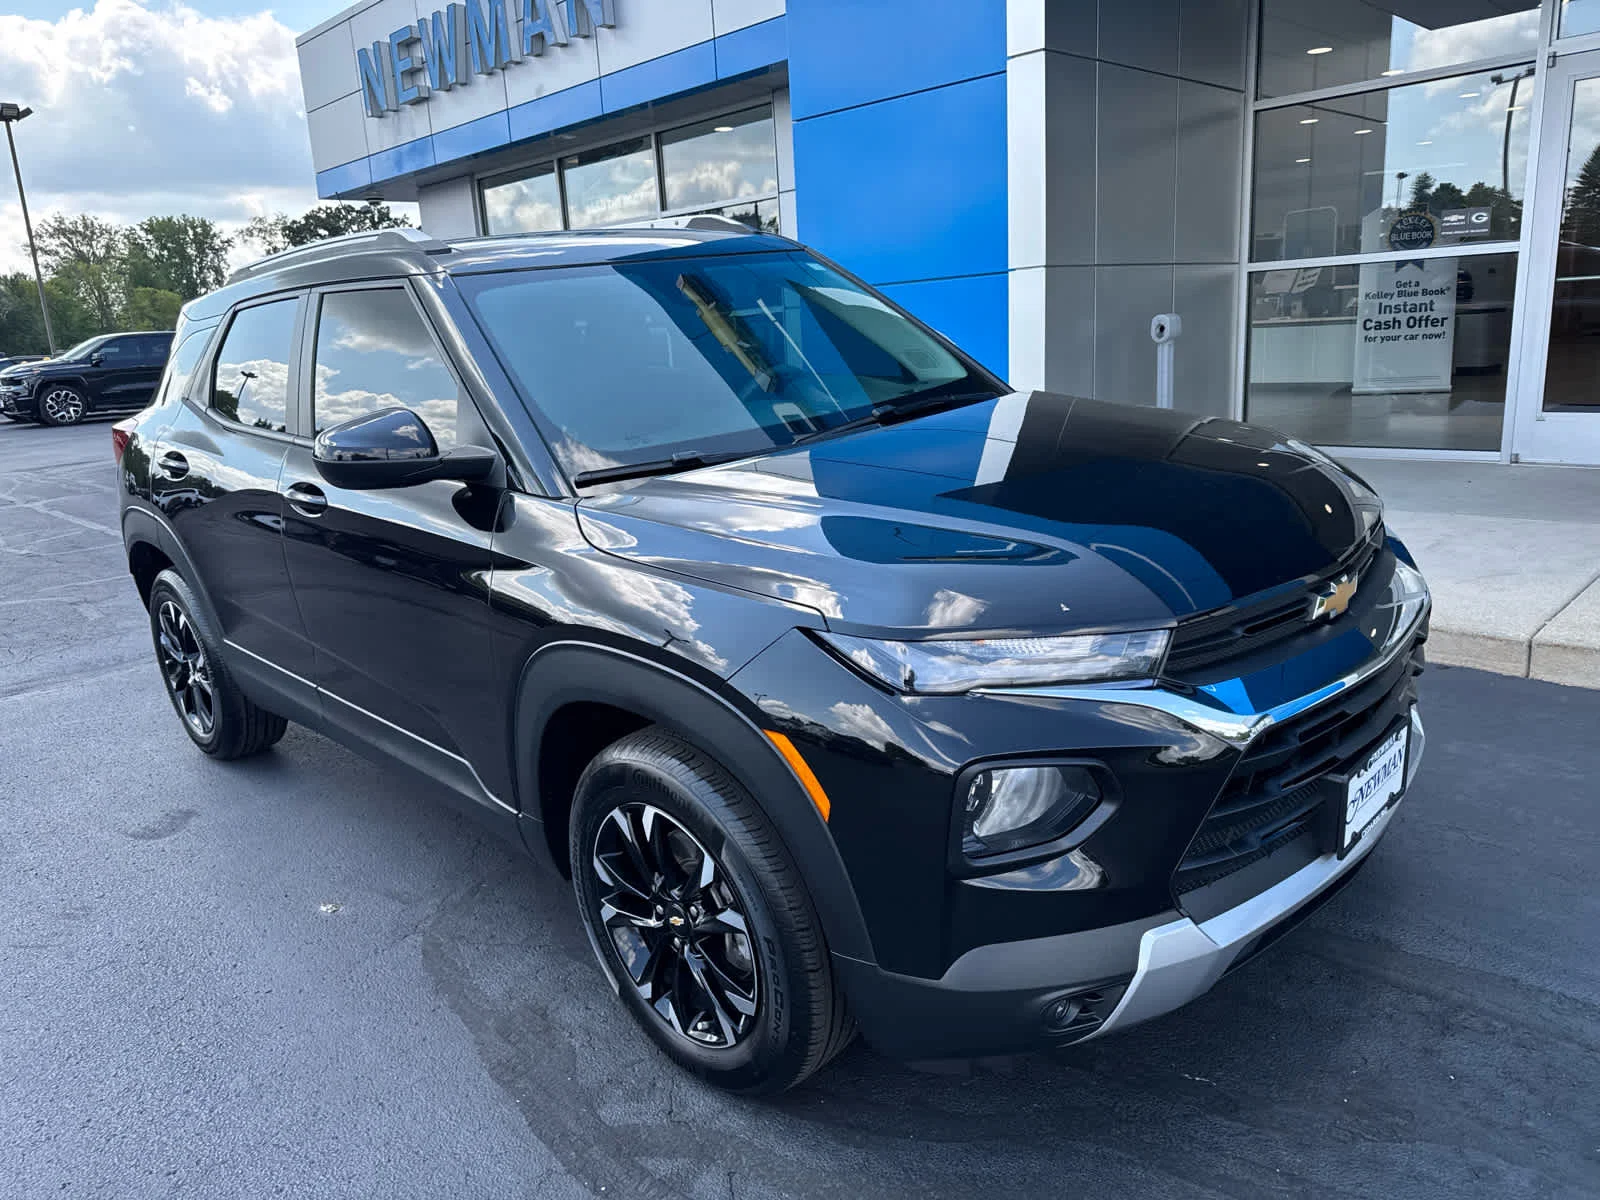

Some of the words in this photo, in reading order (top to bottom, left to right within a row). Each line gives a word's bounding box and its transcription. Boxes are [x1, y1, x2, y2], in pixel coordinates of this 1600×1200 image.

[1395, 280, 1412, 289] Get
[1365, 291, 1395, 301] Kelley
[1397, 290, 1419, 298] Blue
[1378, 300, 1435, 315] Instant
[1363, 317, 1402, 331] Cash
[1406, 315, 1449, 329] Offer
[1364, 335, 1378, 343] for
[1380, 335, 1402, 344] your
[1403, 333, 1420, 341] car
[1421, 331, 1446, 340] now!
[1345, 744, 1405, 825] NEWMAN
